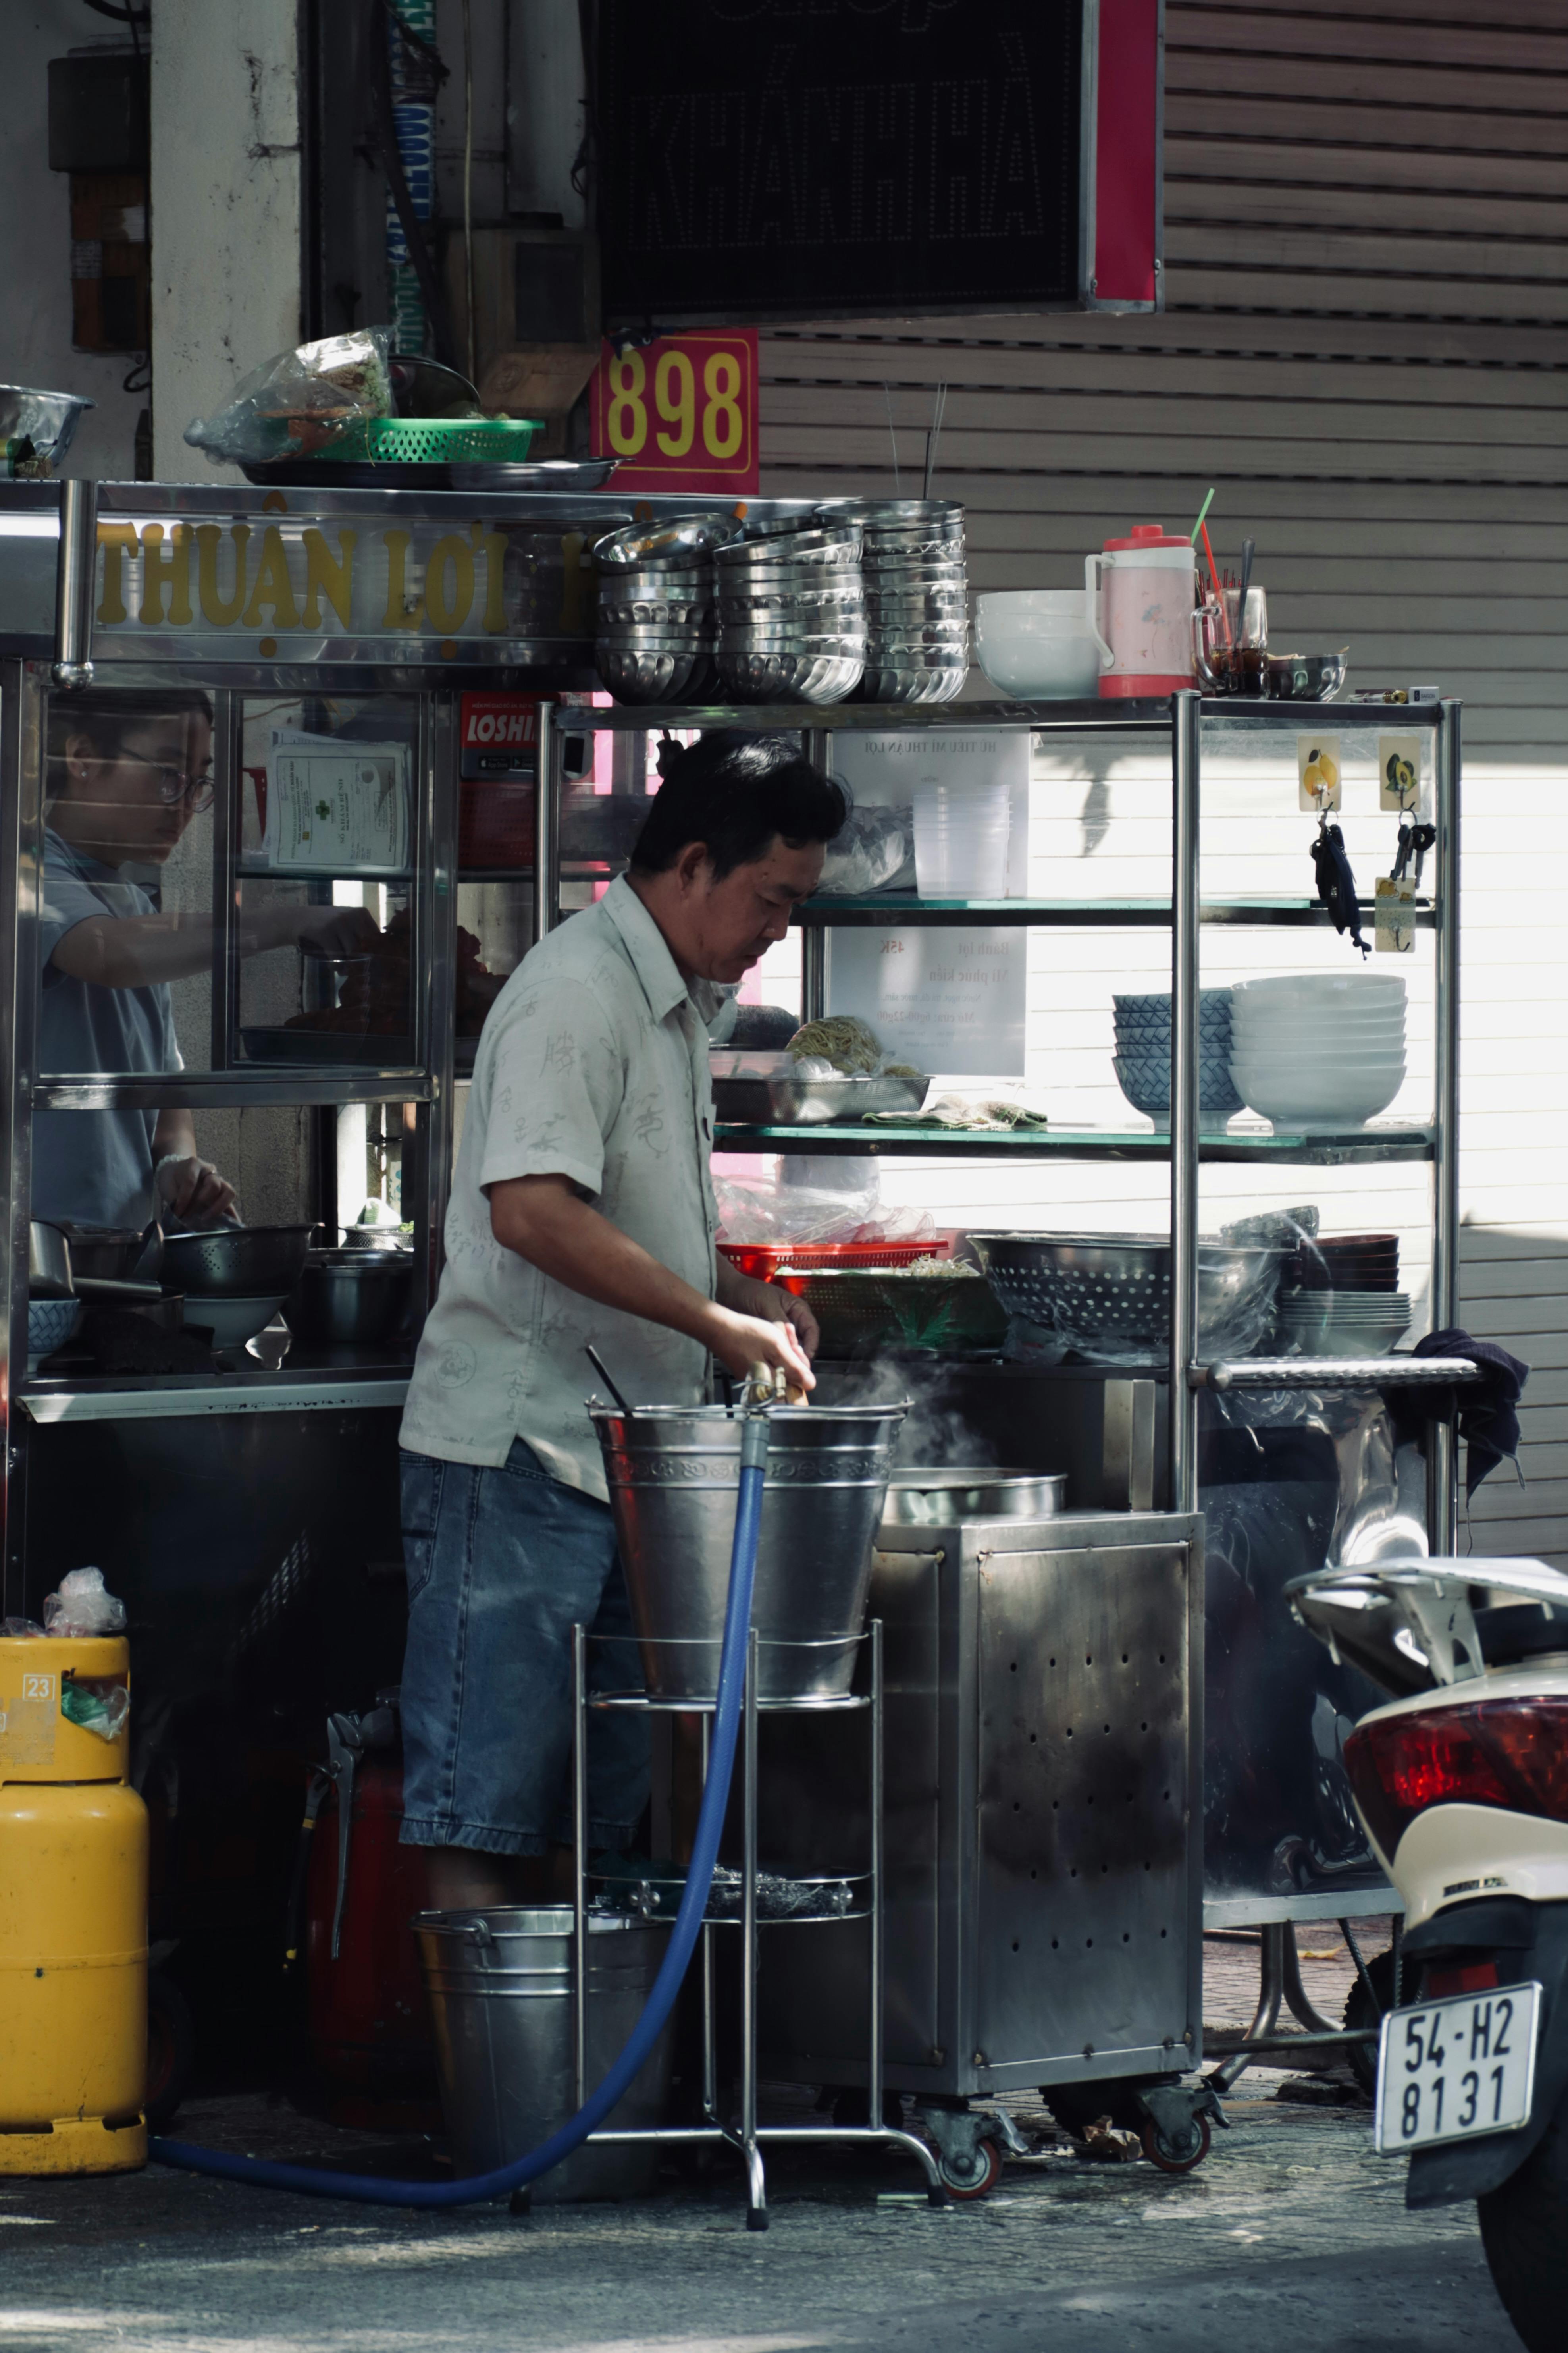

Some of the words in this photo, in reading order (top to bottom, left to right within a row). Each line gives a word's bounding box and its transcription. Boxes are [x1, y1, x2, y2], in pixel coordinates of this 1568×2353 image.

[607, 349, 743, 459] 898
[467, 714, 534, 742] LOSHI
[27, 1678, 50, 1698] 23
[1405, 1998, 1514, 2073] 54-H2
[1401, 2064, 1504, 2139] 8131
